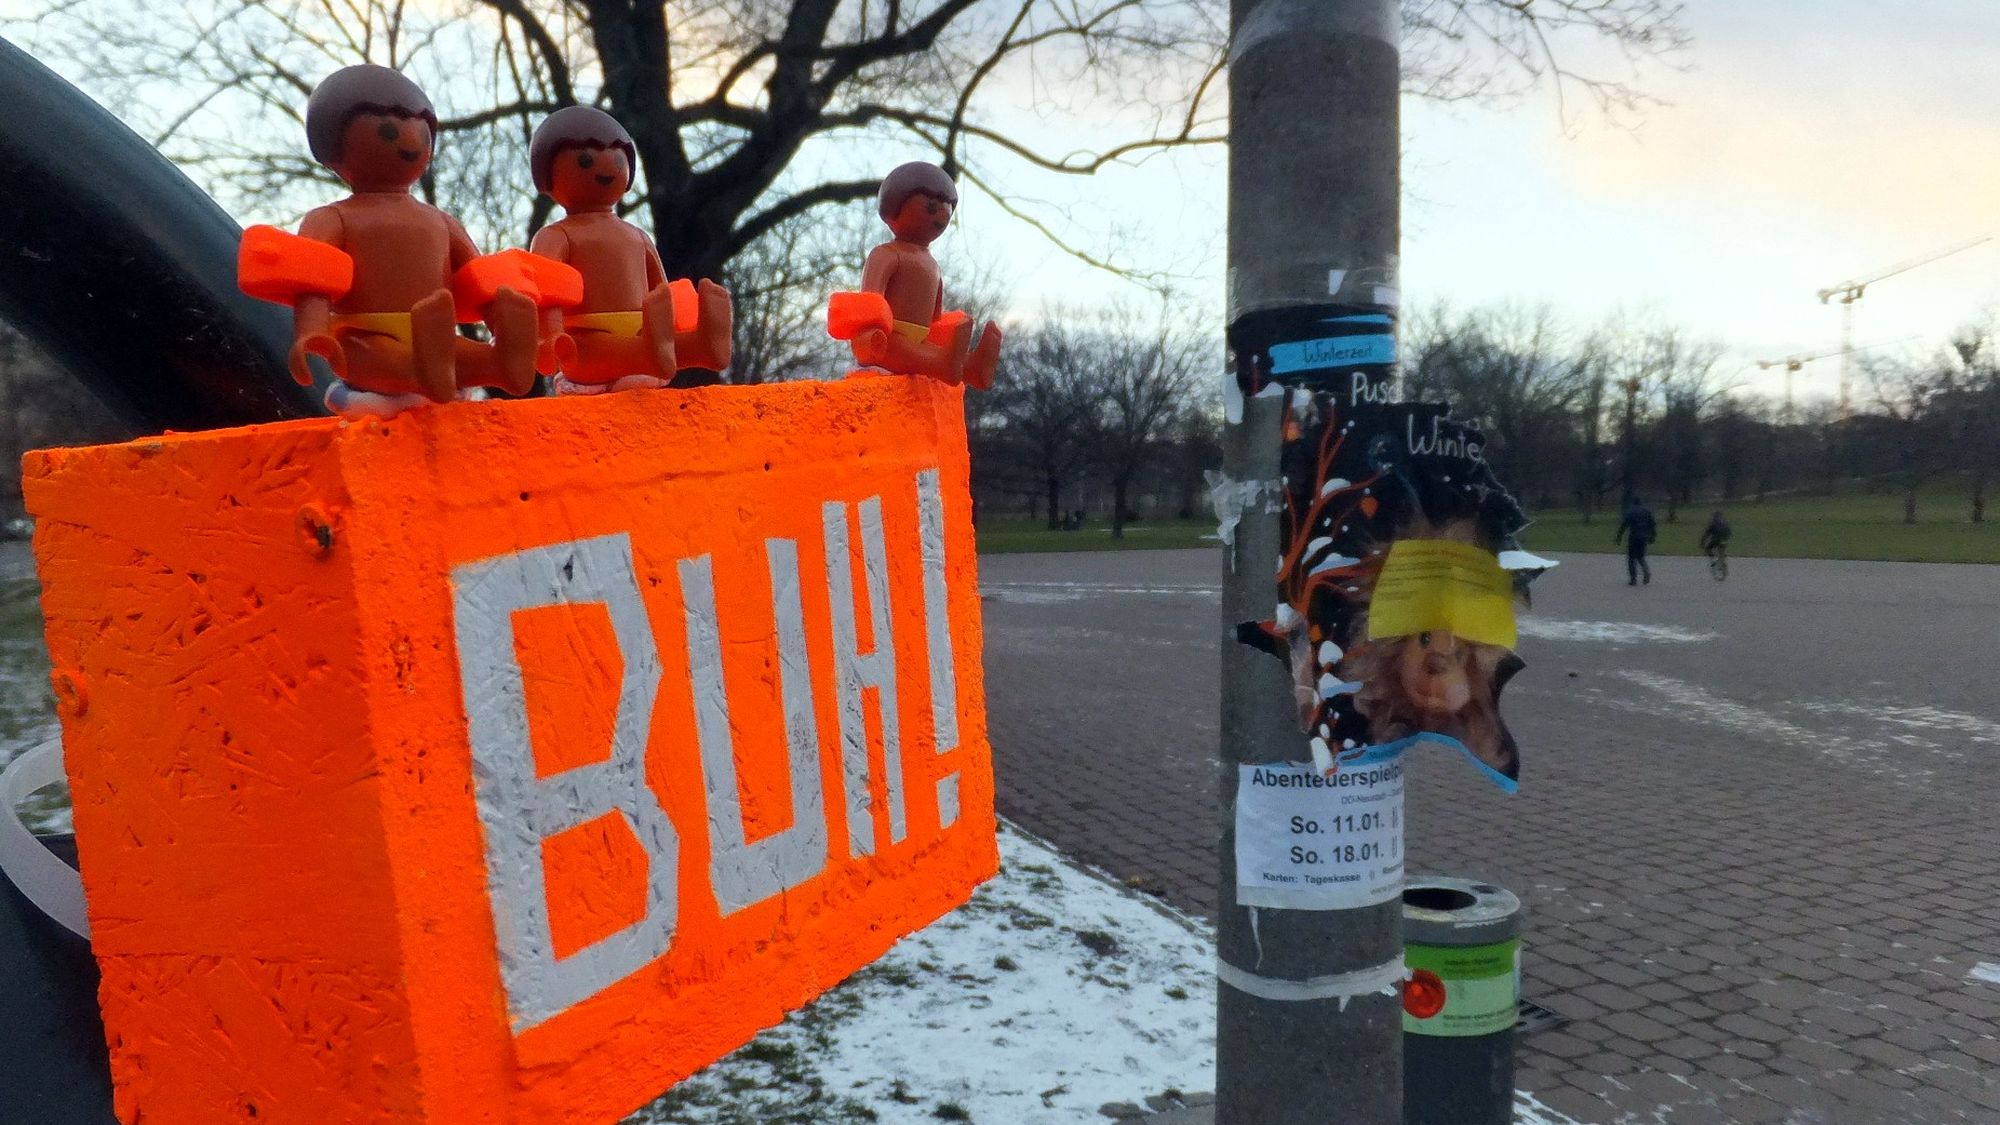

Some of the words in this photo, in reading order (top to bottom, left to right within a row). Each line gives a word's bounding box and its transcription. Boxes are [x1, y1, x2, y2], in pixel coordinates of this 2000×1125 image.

[1303, 343, 1373, 364] Winterzeit
[452, 469, 961, 1036] BUH!
[1290, 815, 1325, 834] So.
[1332, 812, 1385, 833] 11.01.
[1290, 845, 1325, 864] So.
[1332, 843, 1385, 863] 18.01.
[1263, 871, 1298, 883] Karten:
[1304, 873, 1361, 885] Tageskasse
